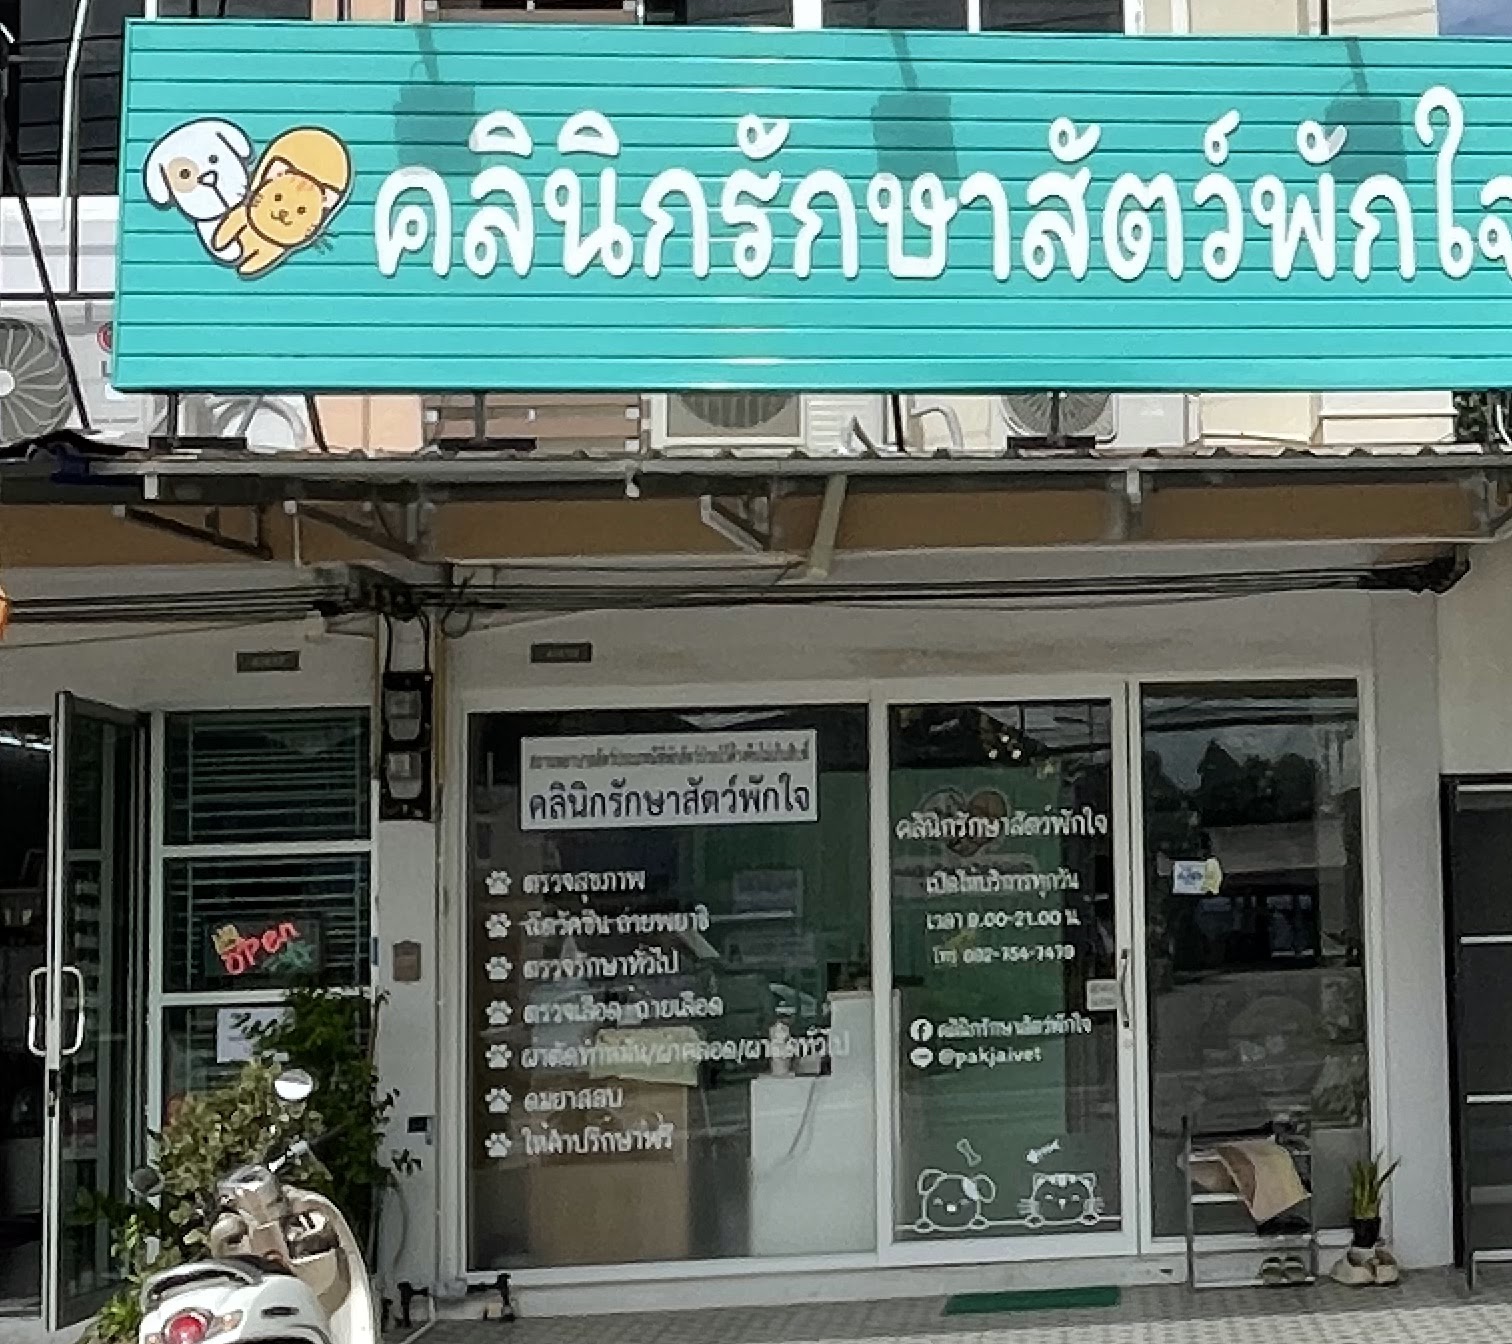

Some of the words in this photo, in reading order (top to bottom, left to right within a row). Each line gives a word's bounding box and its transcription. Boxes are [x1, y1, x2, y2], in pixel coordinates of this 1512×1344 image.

[528, 771, 811, 820] คลินิกรักษาสัตว์พักใจ
[895, 804, 1108, 840] คลินิกรักษาสัตว์พักใจ
[522, 869, 647, 904] ตรวจสุขภาพ
[926, 911, 964, 930] เวลา
[938, 1045, 1042, 1069] @pakjaivet
